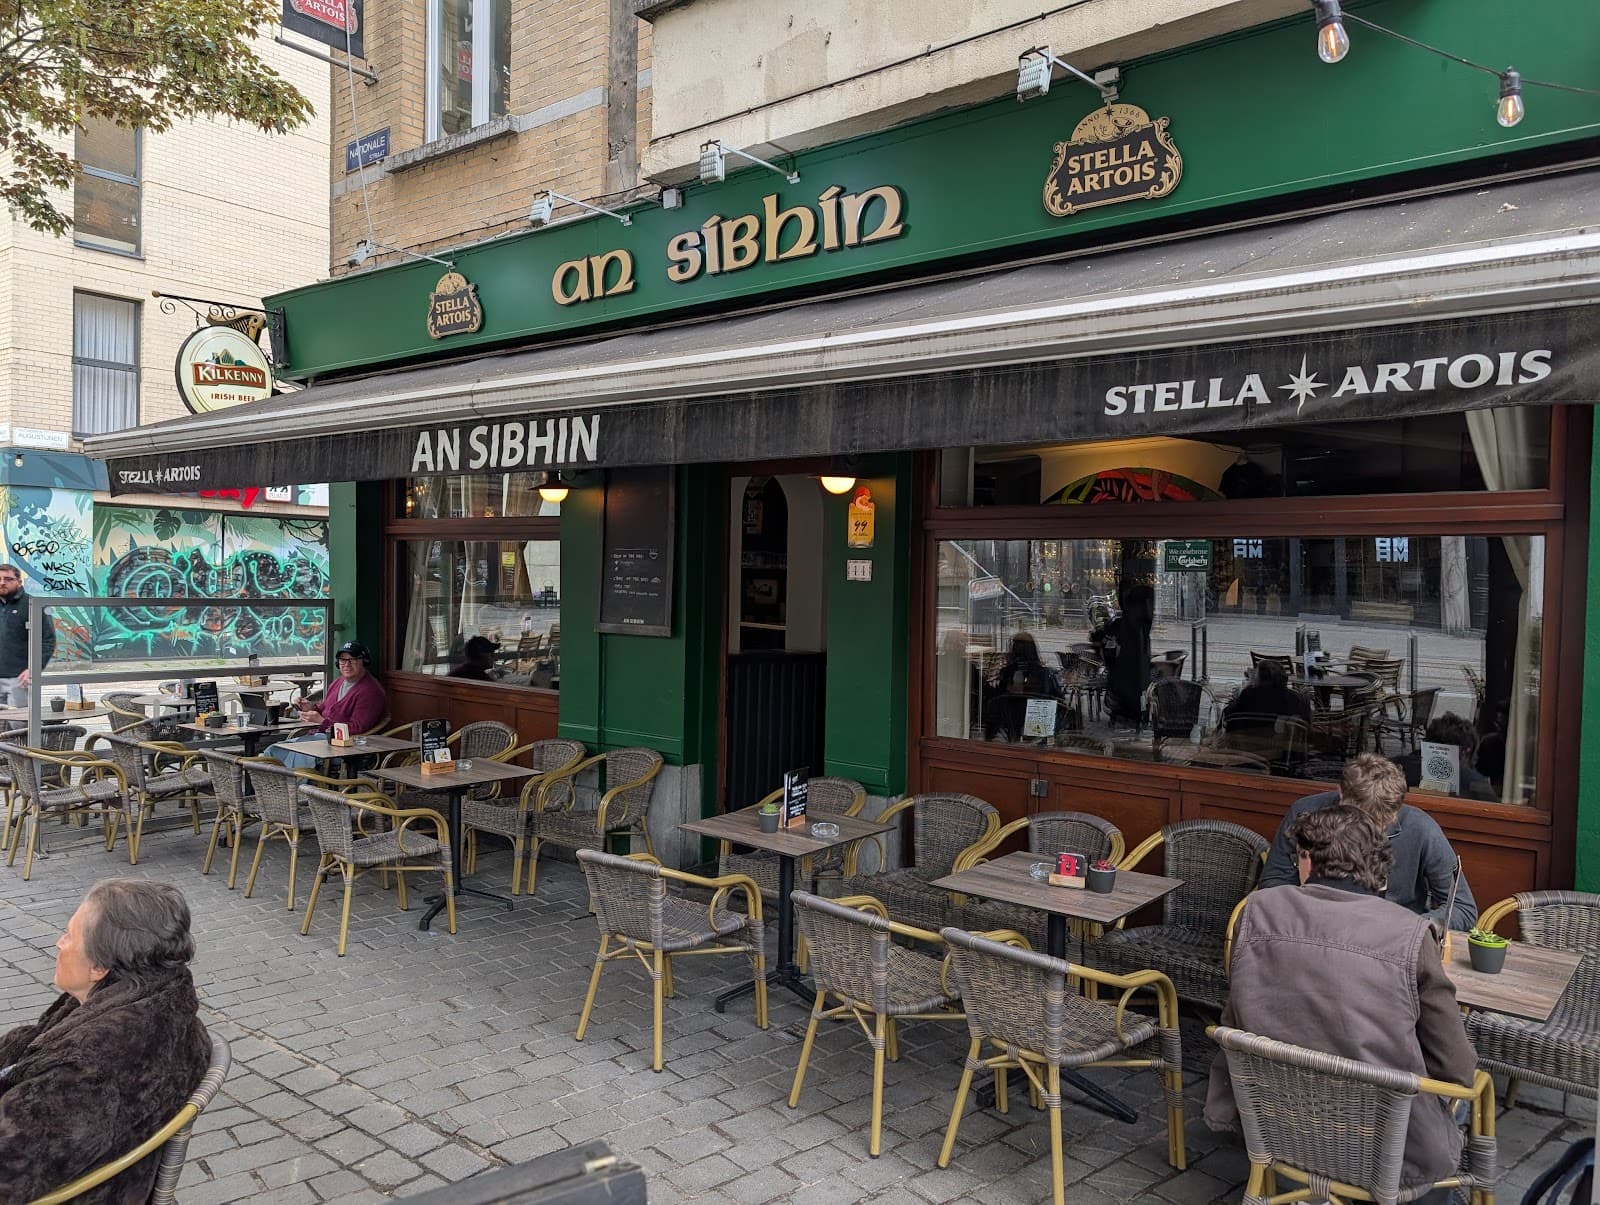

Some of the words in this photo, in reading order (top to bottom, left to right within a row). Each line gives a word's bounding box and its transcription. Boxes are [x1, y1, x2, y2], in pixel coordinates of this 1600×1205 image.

[305, 0, 345, 21] ARTOIS
[1068, 140, 1155, 175] STELLA
[1067, 161, 1156, 196] ARTOIS
[435, 296, 470, 314] STELLA
[437, 309, 471, 327] ARTOIS
[198, 366, 263, 384] KILKENNY
[1104, 373, 1271, 416] STELLA
[1332, 350, 1552, 398] ARTOIS
[211, 393, 235, 401] IRISH
[411, 428, 460, 473] AN
[469, 414, 600, 470] SIBHIN
[118, 469, 154, 485] STELLA
[163, 465, 200, 482] ARTOIS
[1178, 555, 1208, 567] Carlsberg
